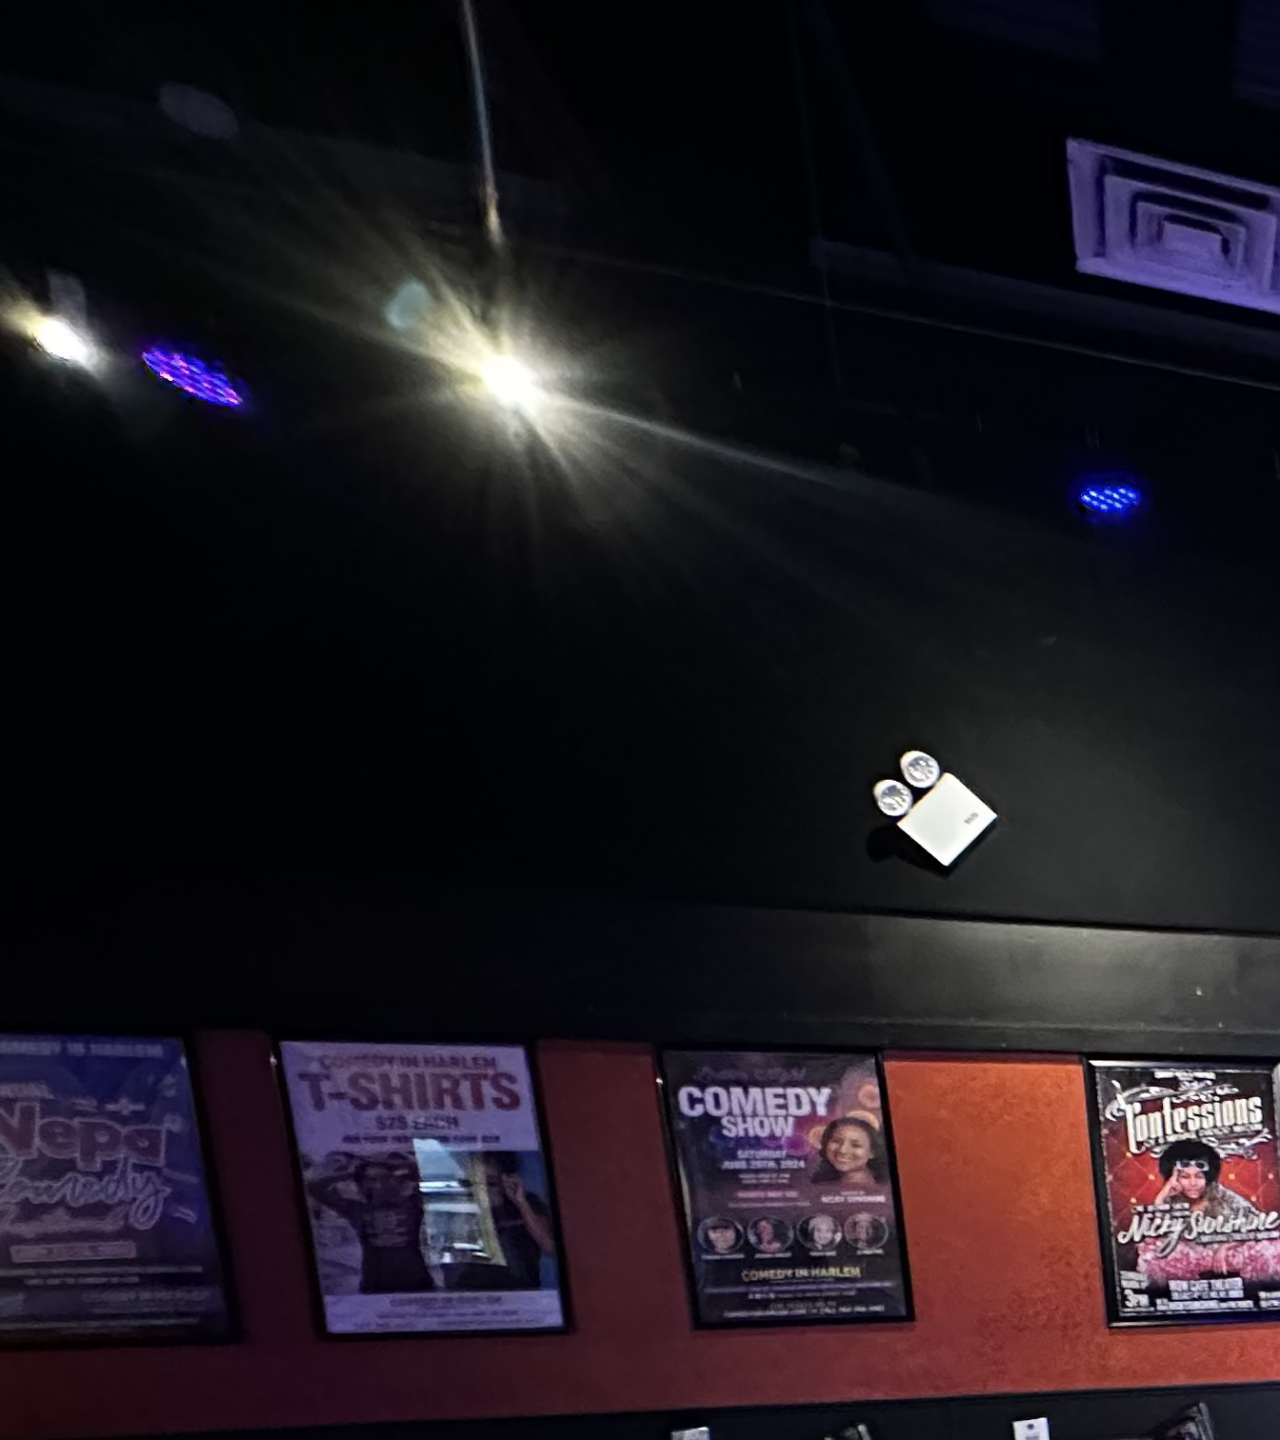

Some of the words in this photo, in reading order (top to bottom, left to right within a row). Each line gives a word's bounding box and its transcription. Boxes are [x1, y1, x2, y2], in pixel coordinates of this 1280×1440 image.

[298, 1072, 521, 1112] T-SHIRTS
[677, 1085, 832, 1117] COMEDY
[720, 1115, 795, 1138] SHOW
